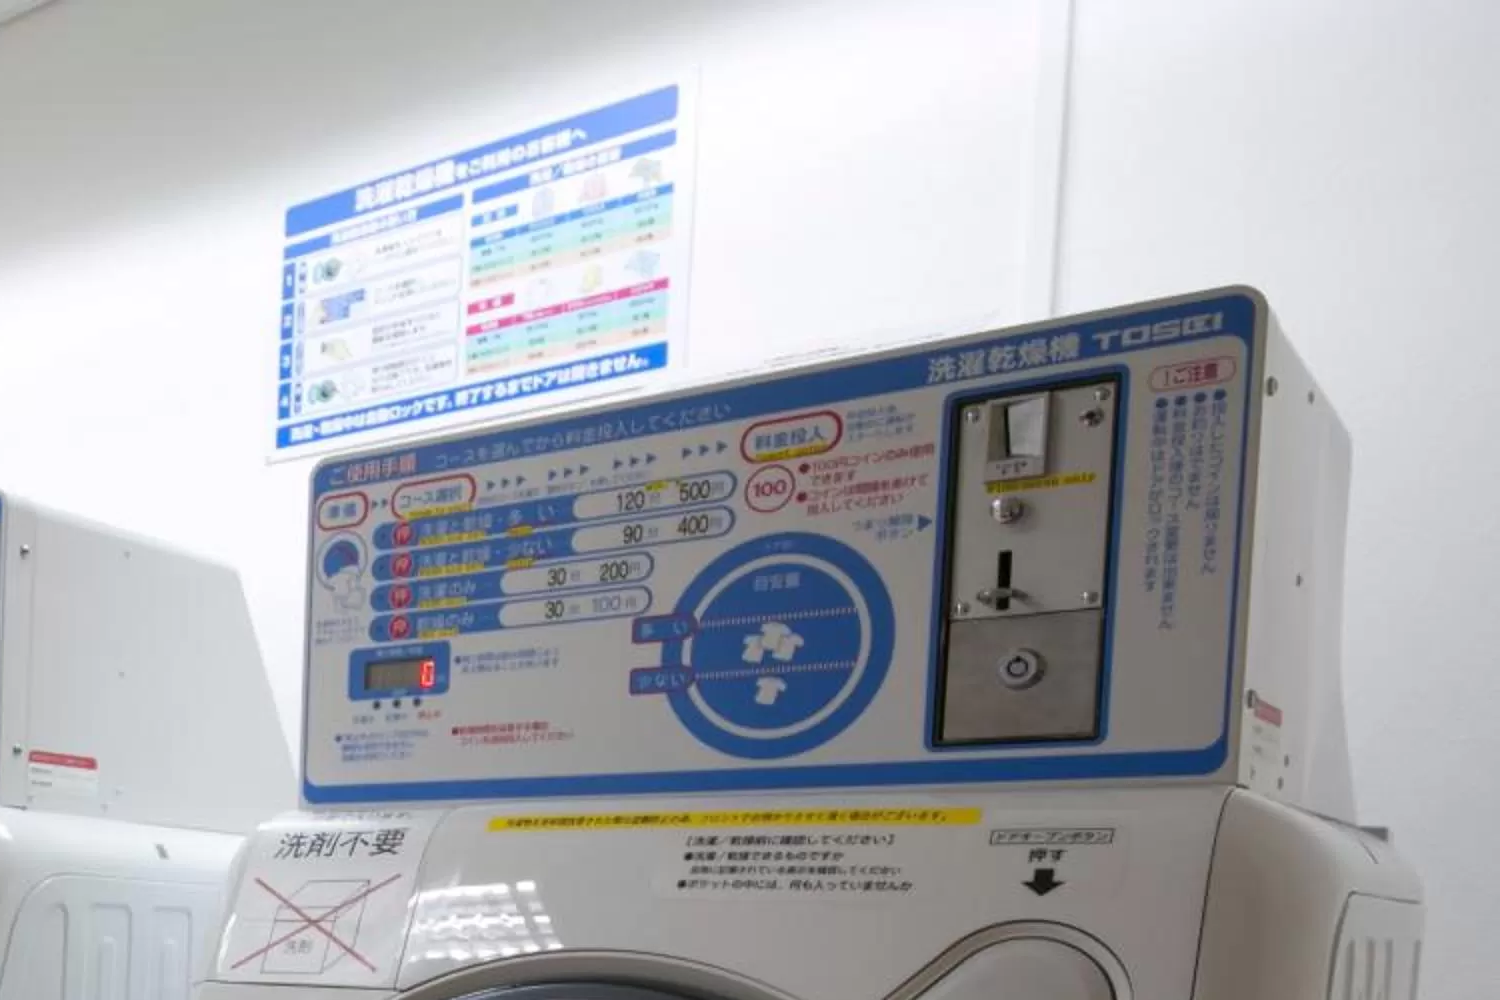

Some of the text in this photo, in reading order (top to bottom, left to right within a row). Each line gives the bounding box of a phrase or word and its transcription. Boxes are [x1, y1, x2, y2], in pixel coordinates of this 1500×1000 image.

[927, 332, 1081, 382] 洗濯乾燥機
[754, 480, 787, 497] 100
[616, 490, 645, 513] 120
[623, 524, 643, 545] 90
[547, 568, 567, 587] 30
[545, 599, 564, 619] 30
[419, 659, 436, 688] 0
[274, 827, 406, 859] 洗剤不要
[1027, 847, 1069, 863] 押す
